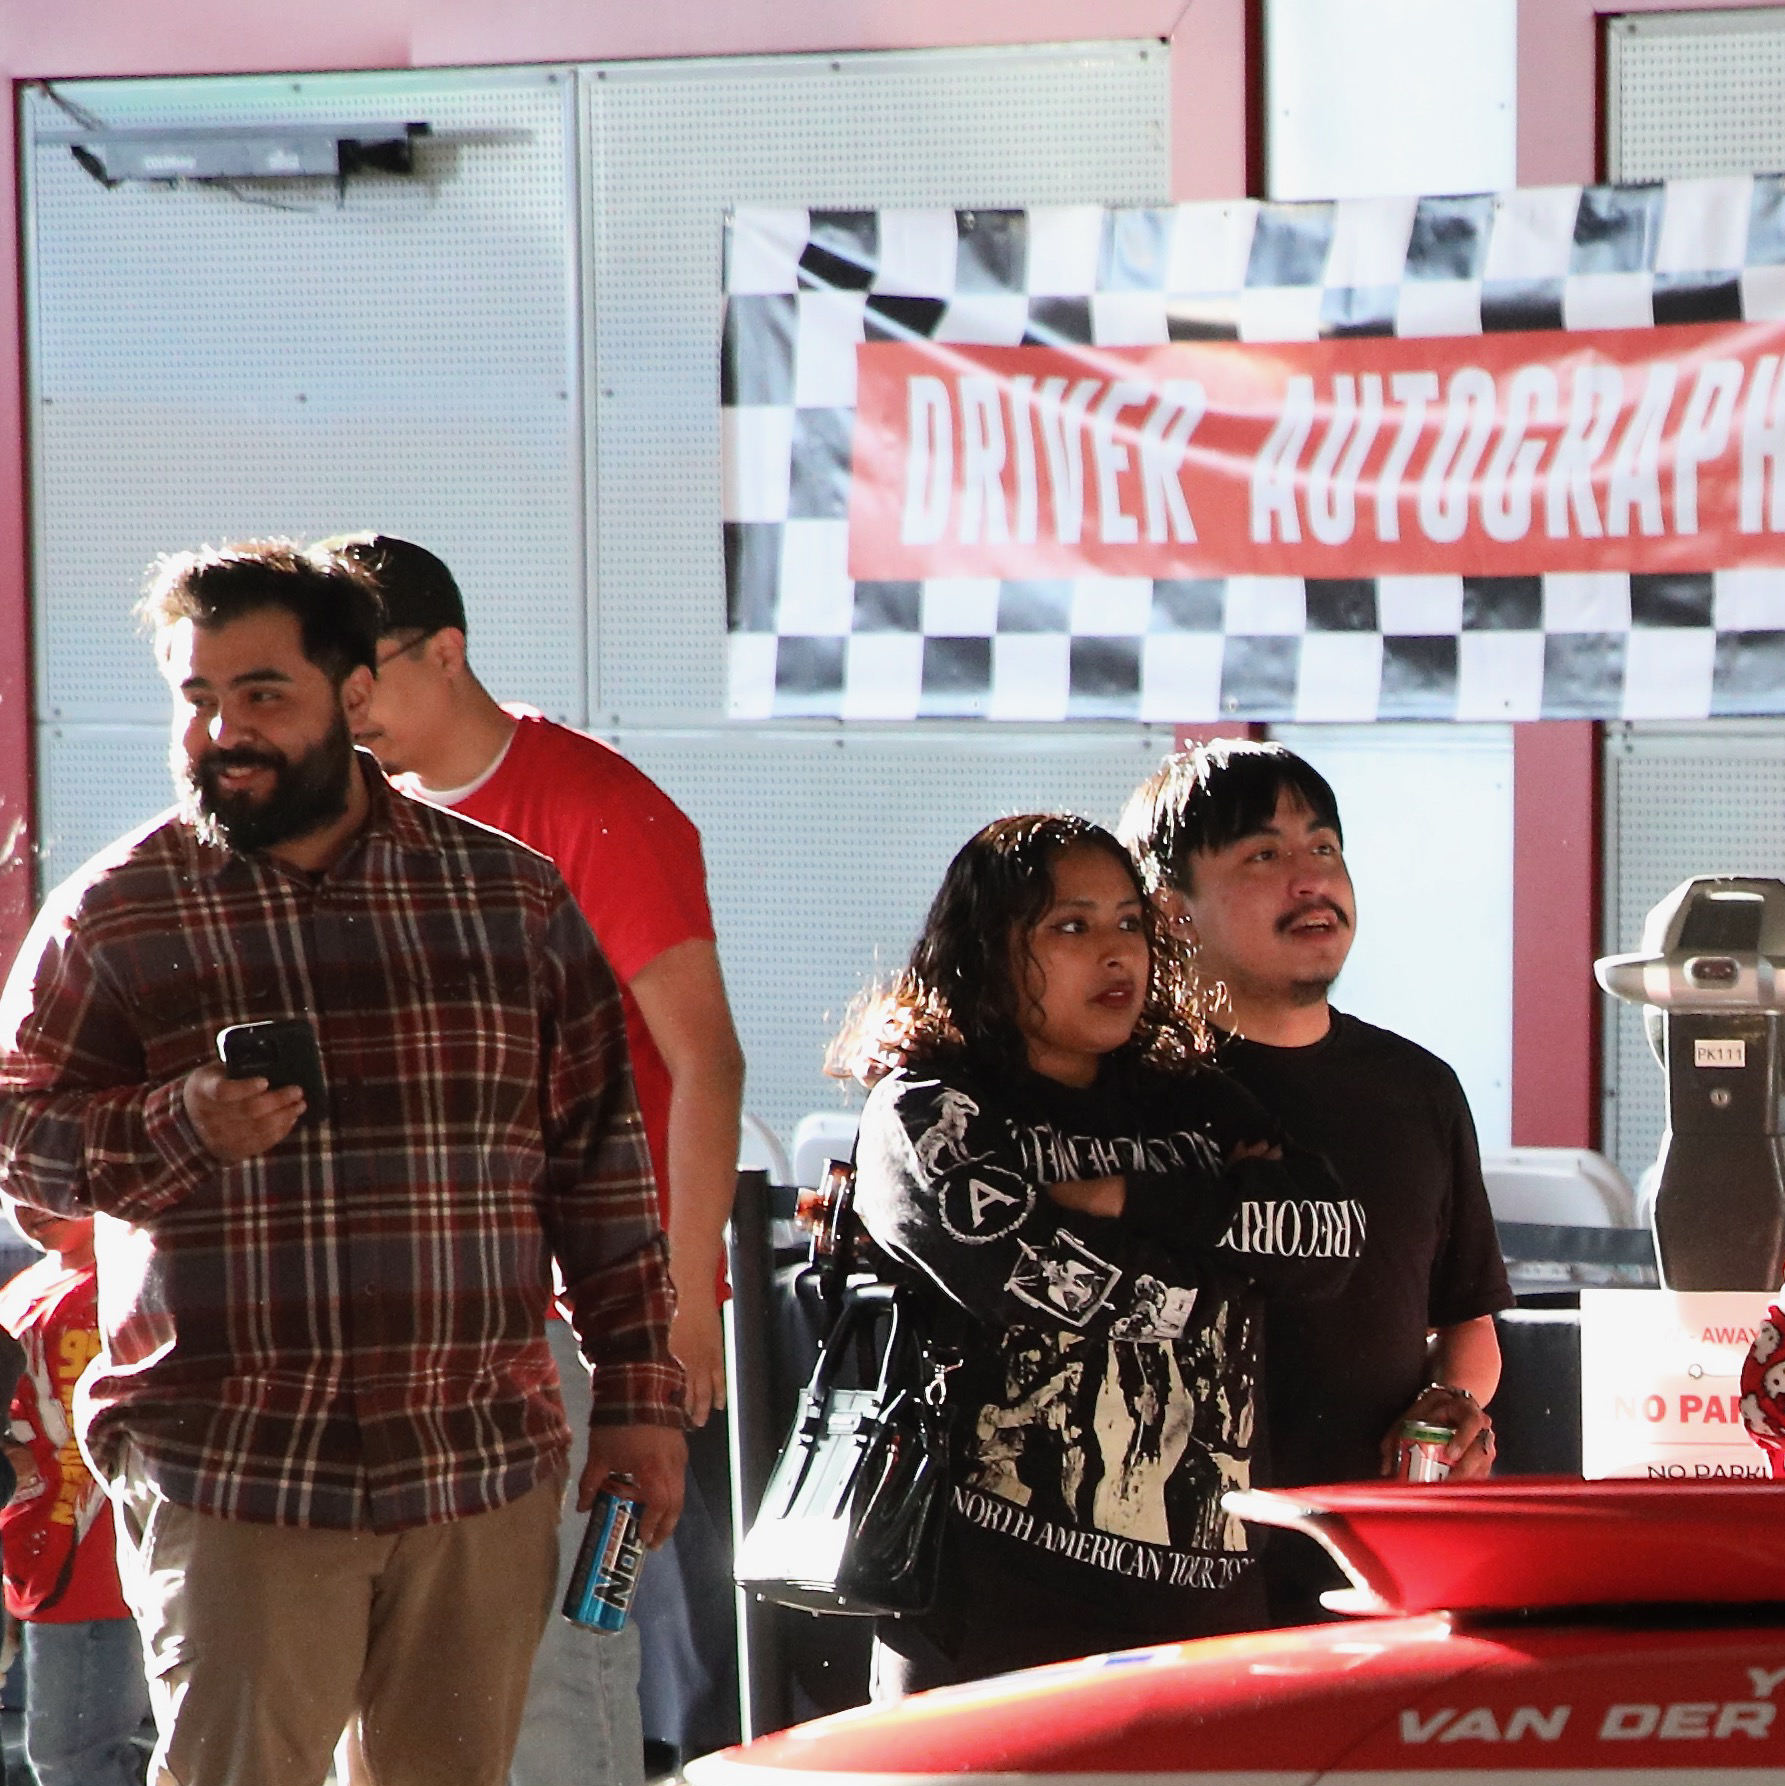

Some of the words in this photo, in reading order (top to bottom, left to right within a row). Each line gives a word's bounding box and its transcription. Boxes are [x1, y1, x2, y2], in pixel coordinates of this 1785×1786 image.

[897, 374, 1205, 548] DRIVER
[1697, 1047, 1743, 1061] PK111
[1614, 1394, 1667, 1423] NO
[951, 1485, 1035, 1542] NORTH
[1034, 1521, 1165, 1582] AMERICAN
[1168, 1551, 1217, 1590] TOUR
[1400, 1704, 1571, 1743] VAN
[1600, 1703, 1778, 1741] DER
